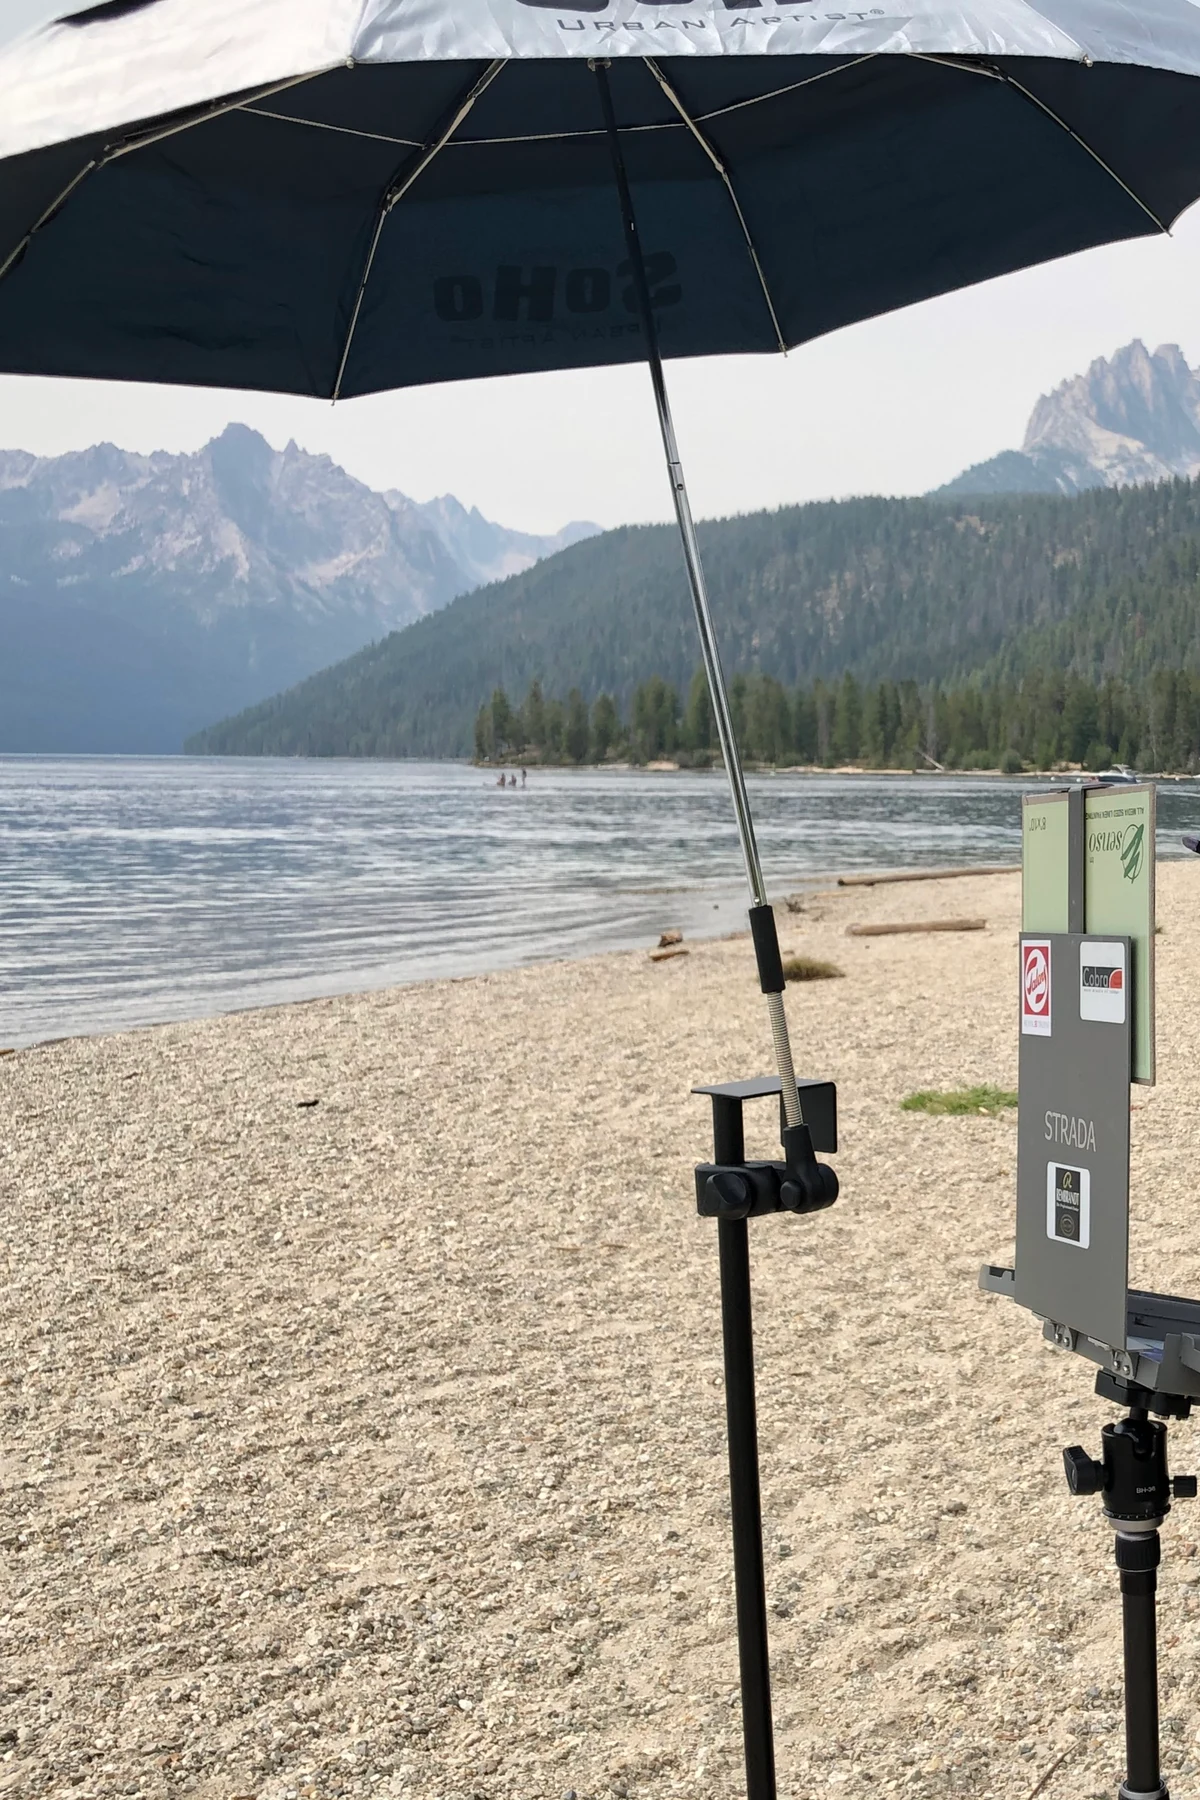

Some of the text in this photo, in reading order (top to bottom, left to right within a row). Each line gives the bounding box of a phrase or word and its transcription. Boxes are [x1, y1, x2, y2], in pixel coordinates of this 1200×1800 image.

[556, 19, 706, 31] URBAN
[1088, 831, 1122, 852] senso
[1083, 967, 1109, 987] Cobra
[1044, 1110, 1096, 1152] STRADA
